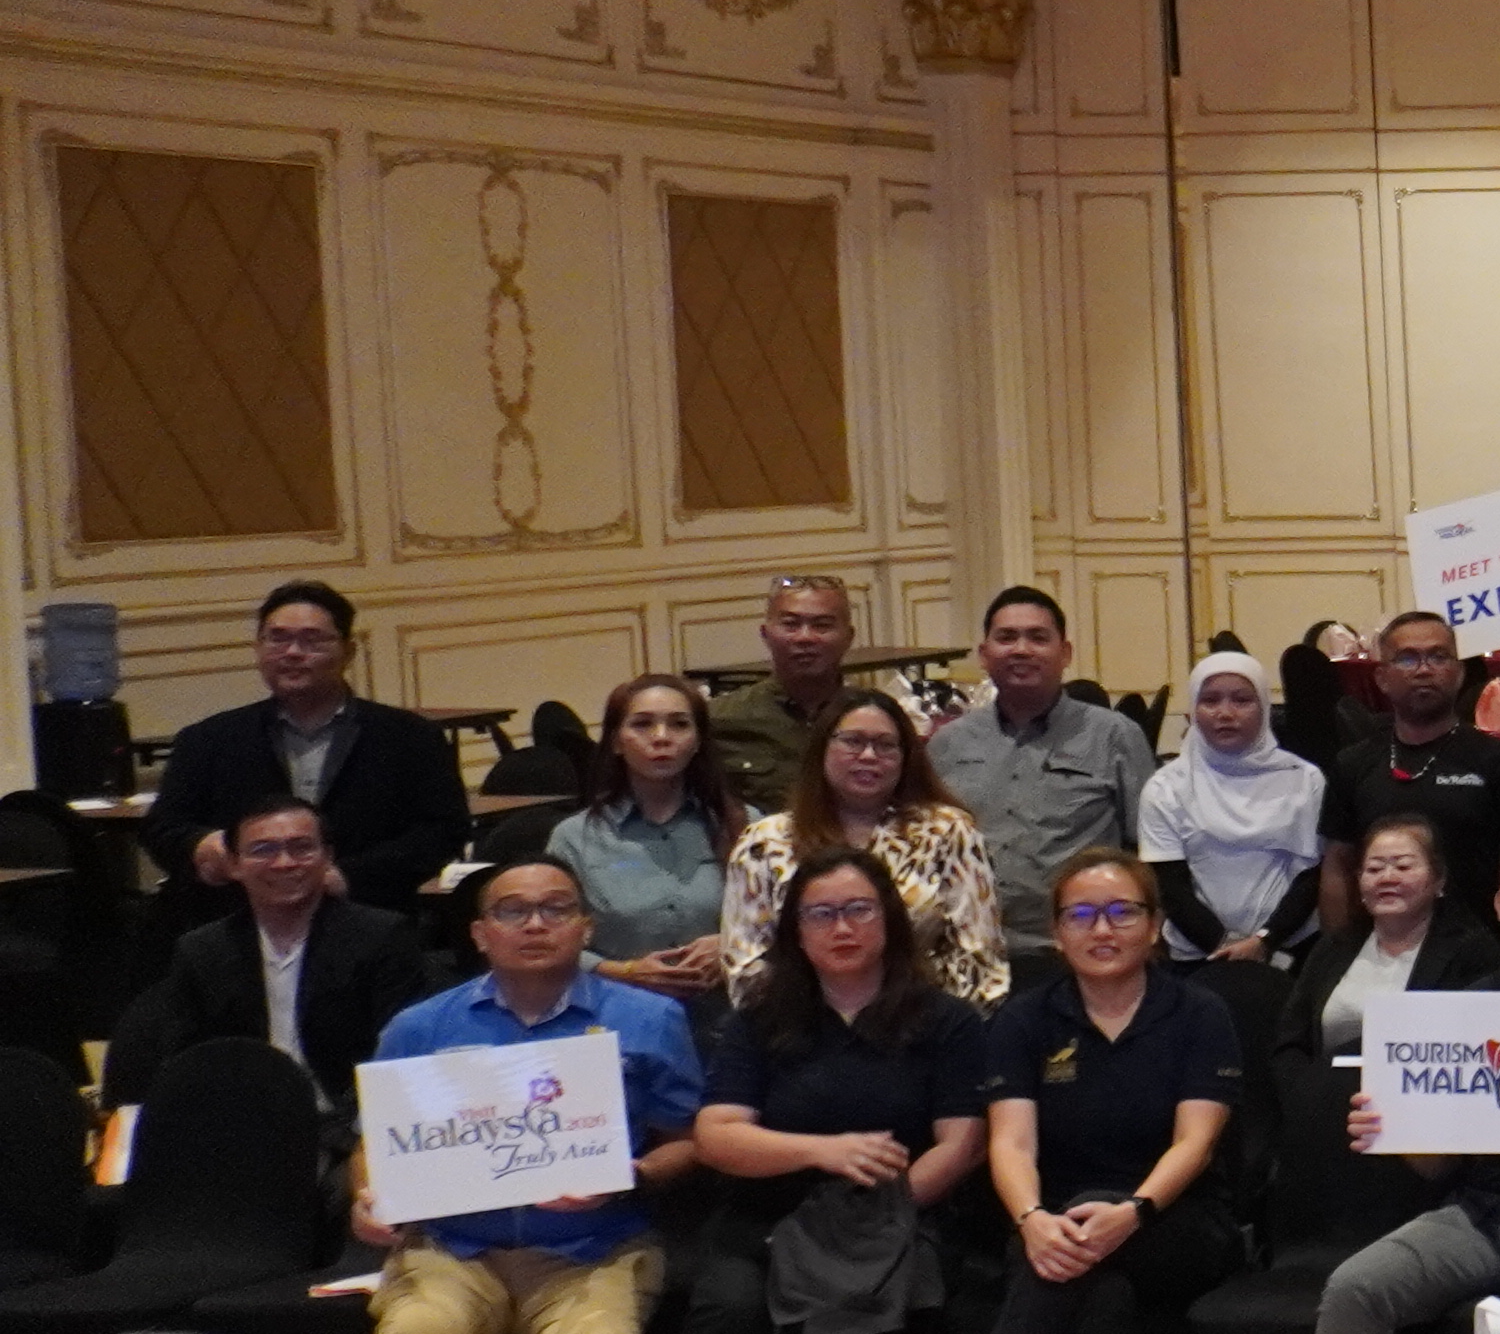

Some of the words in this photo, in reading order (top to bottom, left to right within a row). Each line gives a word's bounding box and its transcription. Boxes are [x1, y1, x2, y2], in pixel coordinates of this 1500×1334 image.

[1441, 559, 1491, 584] MEET
[1384, 1042, 1485, 1063] TOURISM
[388, 1103, 562, 1156] Malaysia
[490, 1143, 557, 1179] Truly
[562, 1139, 610, 1160] Asia
